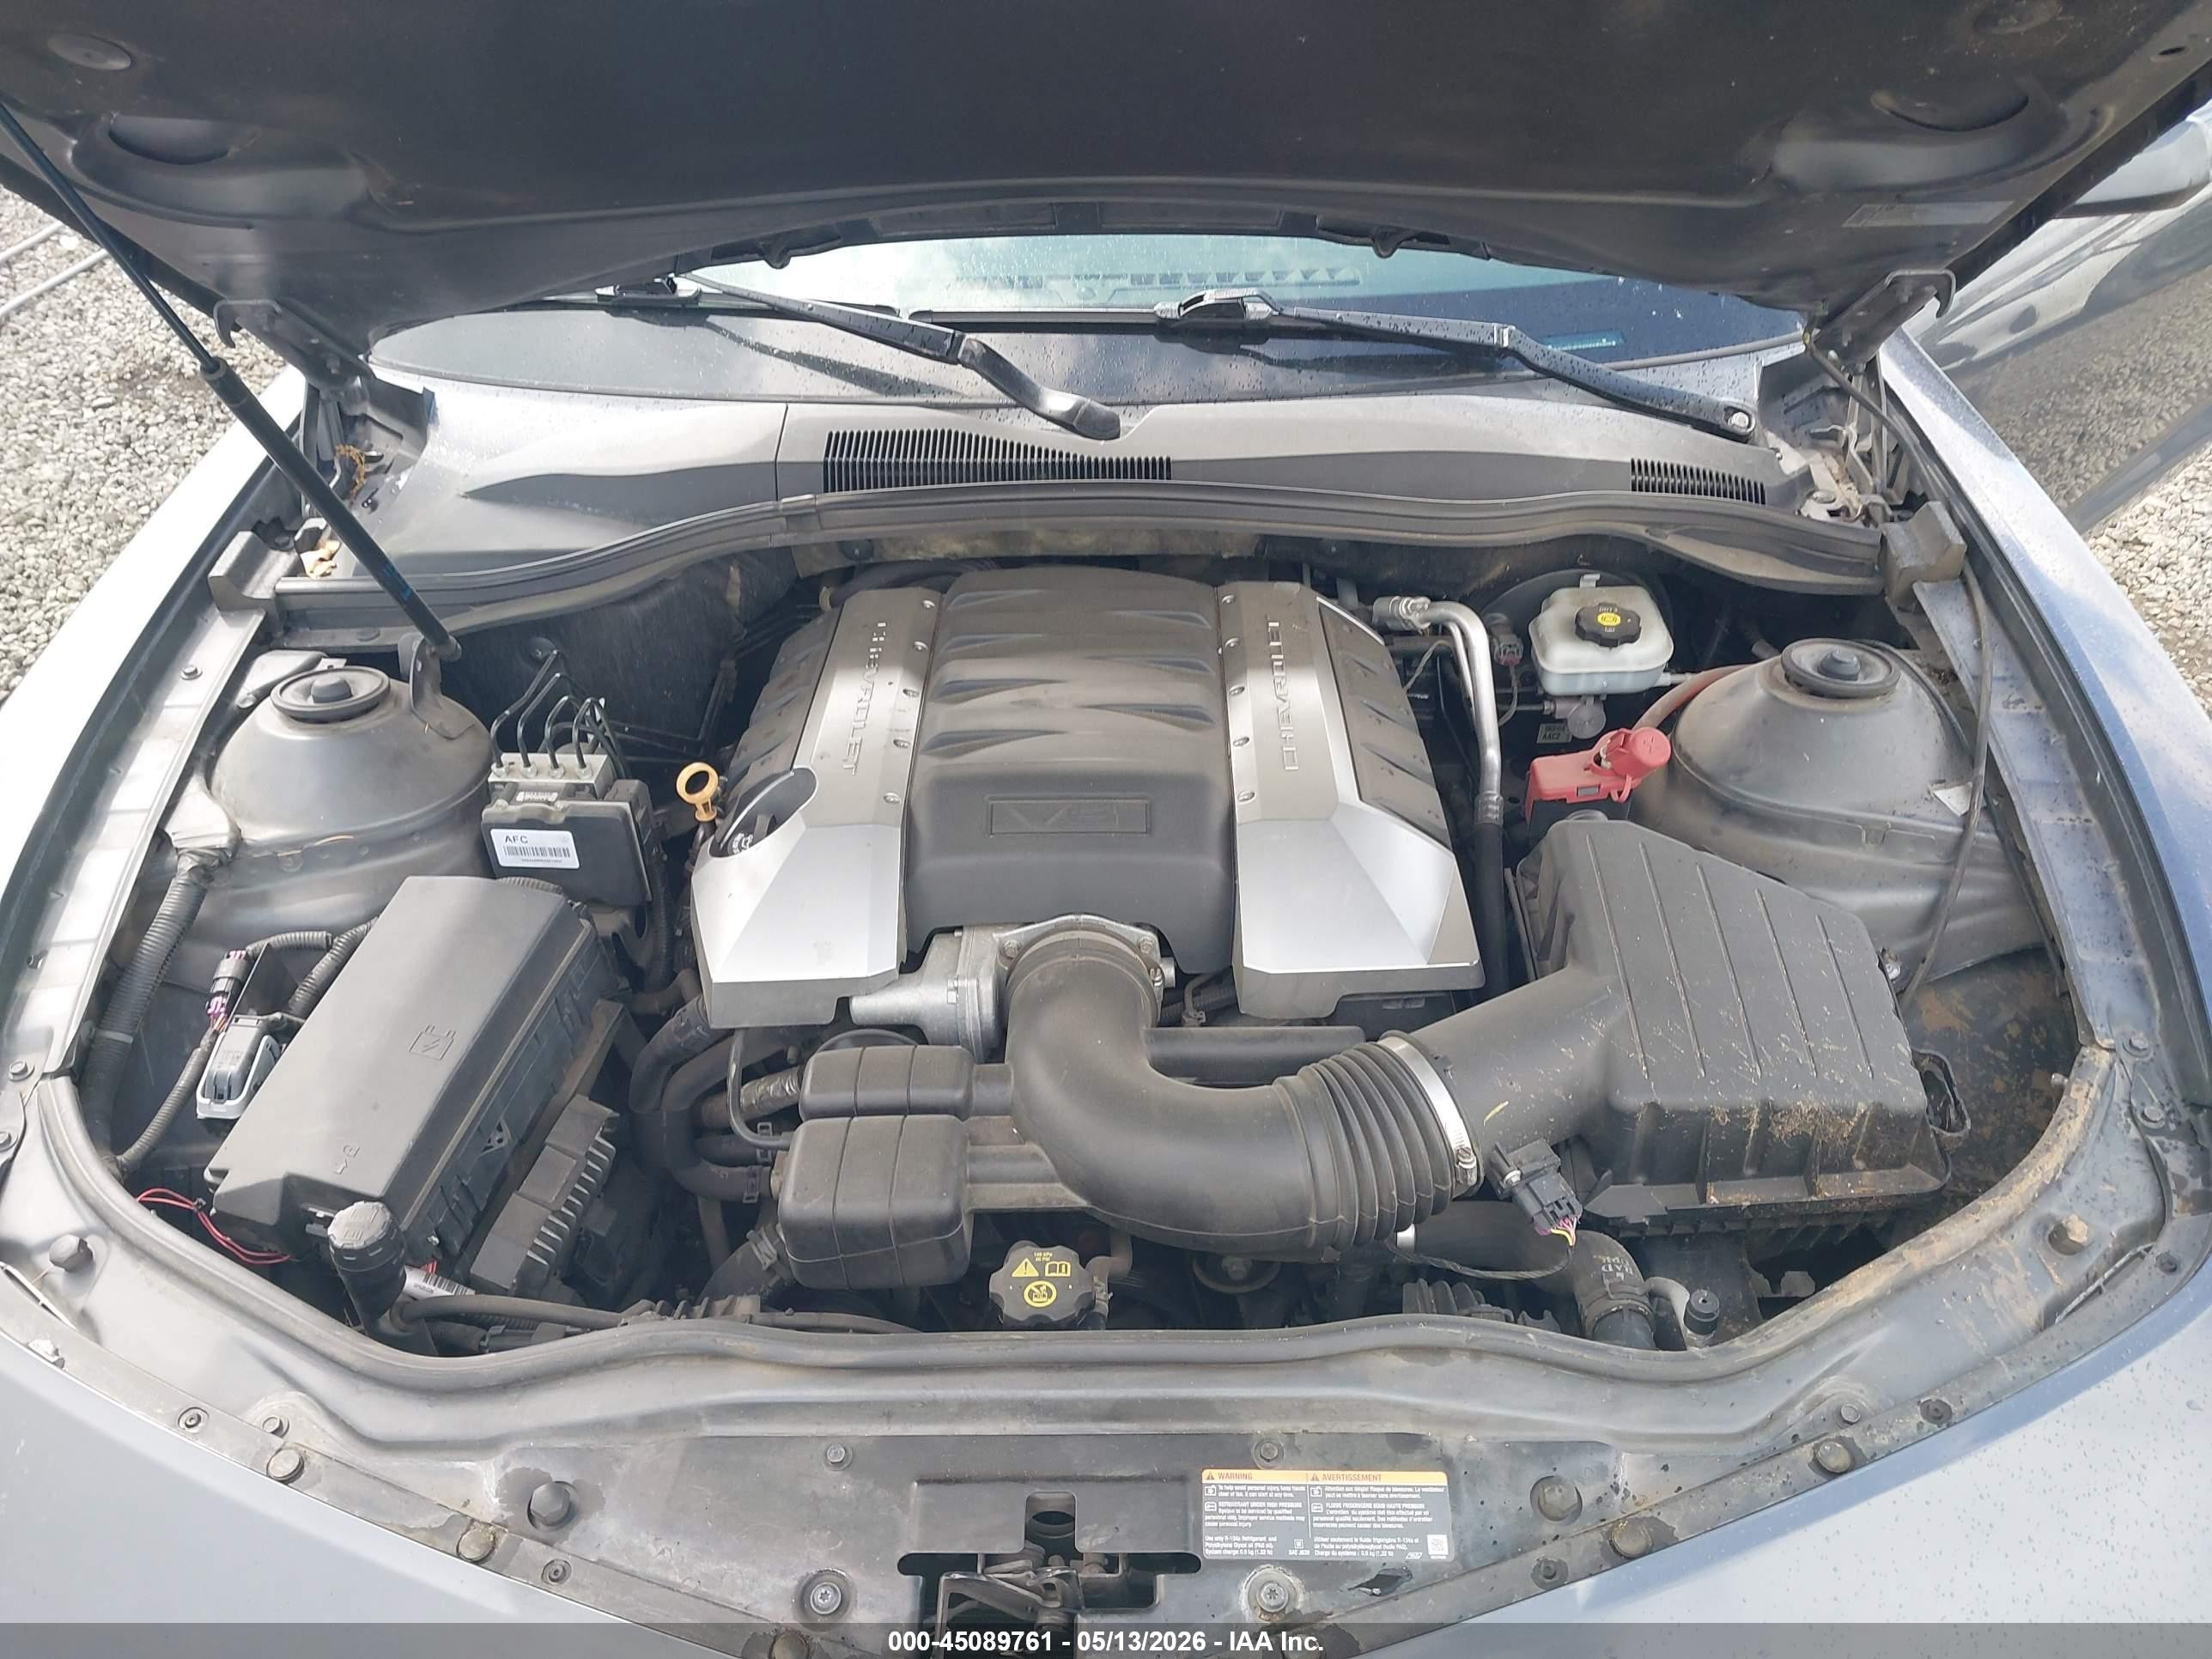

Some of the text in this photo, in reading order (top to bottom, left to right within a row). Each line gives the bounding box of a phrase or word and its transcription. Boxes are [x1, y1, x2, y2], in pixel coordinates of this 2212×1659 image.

[504, 834, 529, 844] AFC
[1218, 1472, 1253, 1480] WARNING
[1322, 1474, 1382, 1482] AVERTISSEMENT
